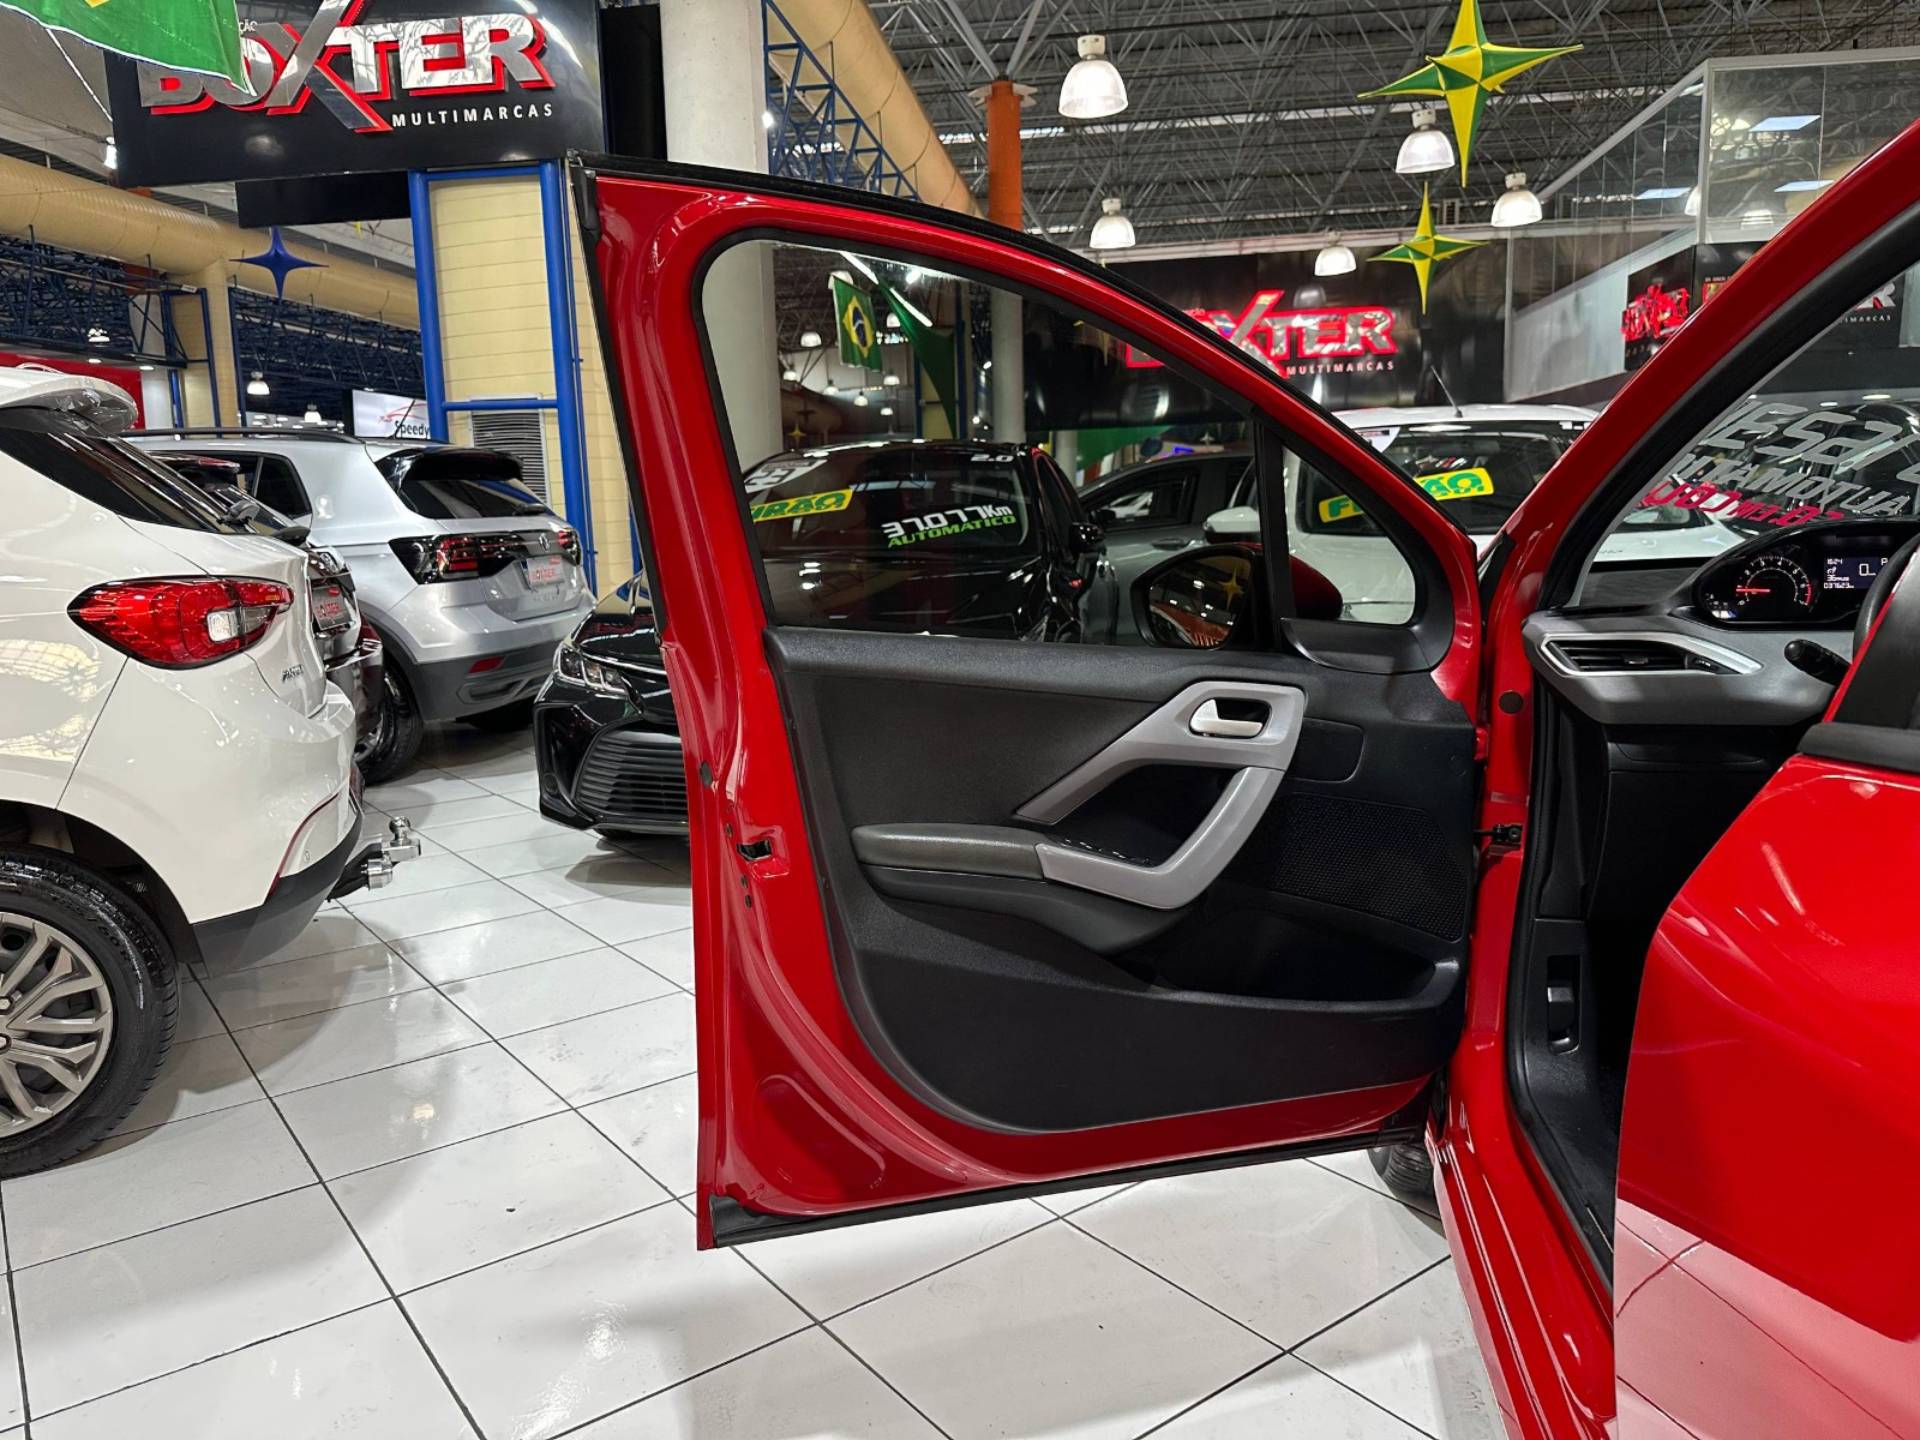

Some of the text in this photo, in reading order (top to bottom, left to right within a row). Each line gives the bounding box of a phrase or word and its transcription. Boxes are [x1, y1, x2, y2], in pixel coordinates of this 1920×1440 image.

[392, 103, 553, 127] MULTIMARCAS
[1286, 361, 1394, 375] MULTIMARCAS
[971, 454, 1014, 462] 2.0
[888, 515, 1016, 548] AUTOMATICO
